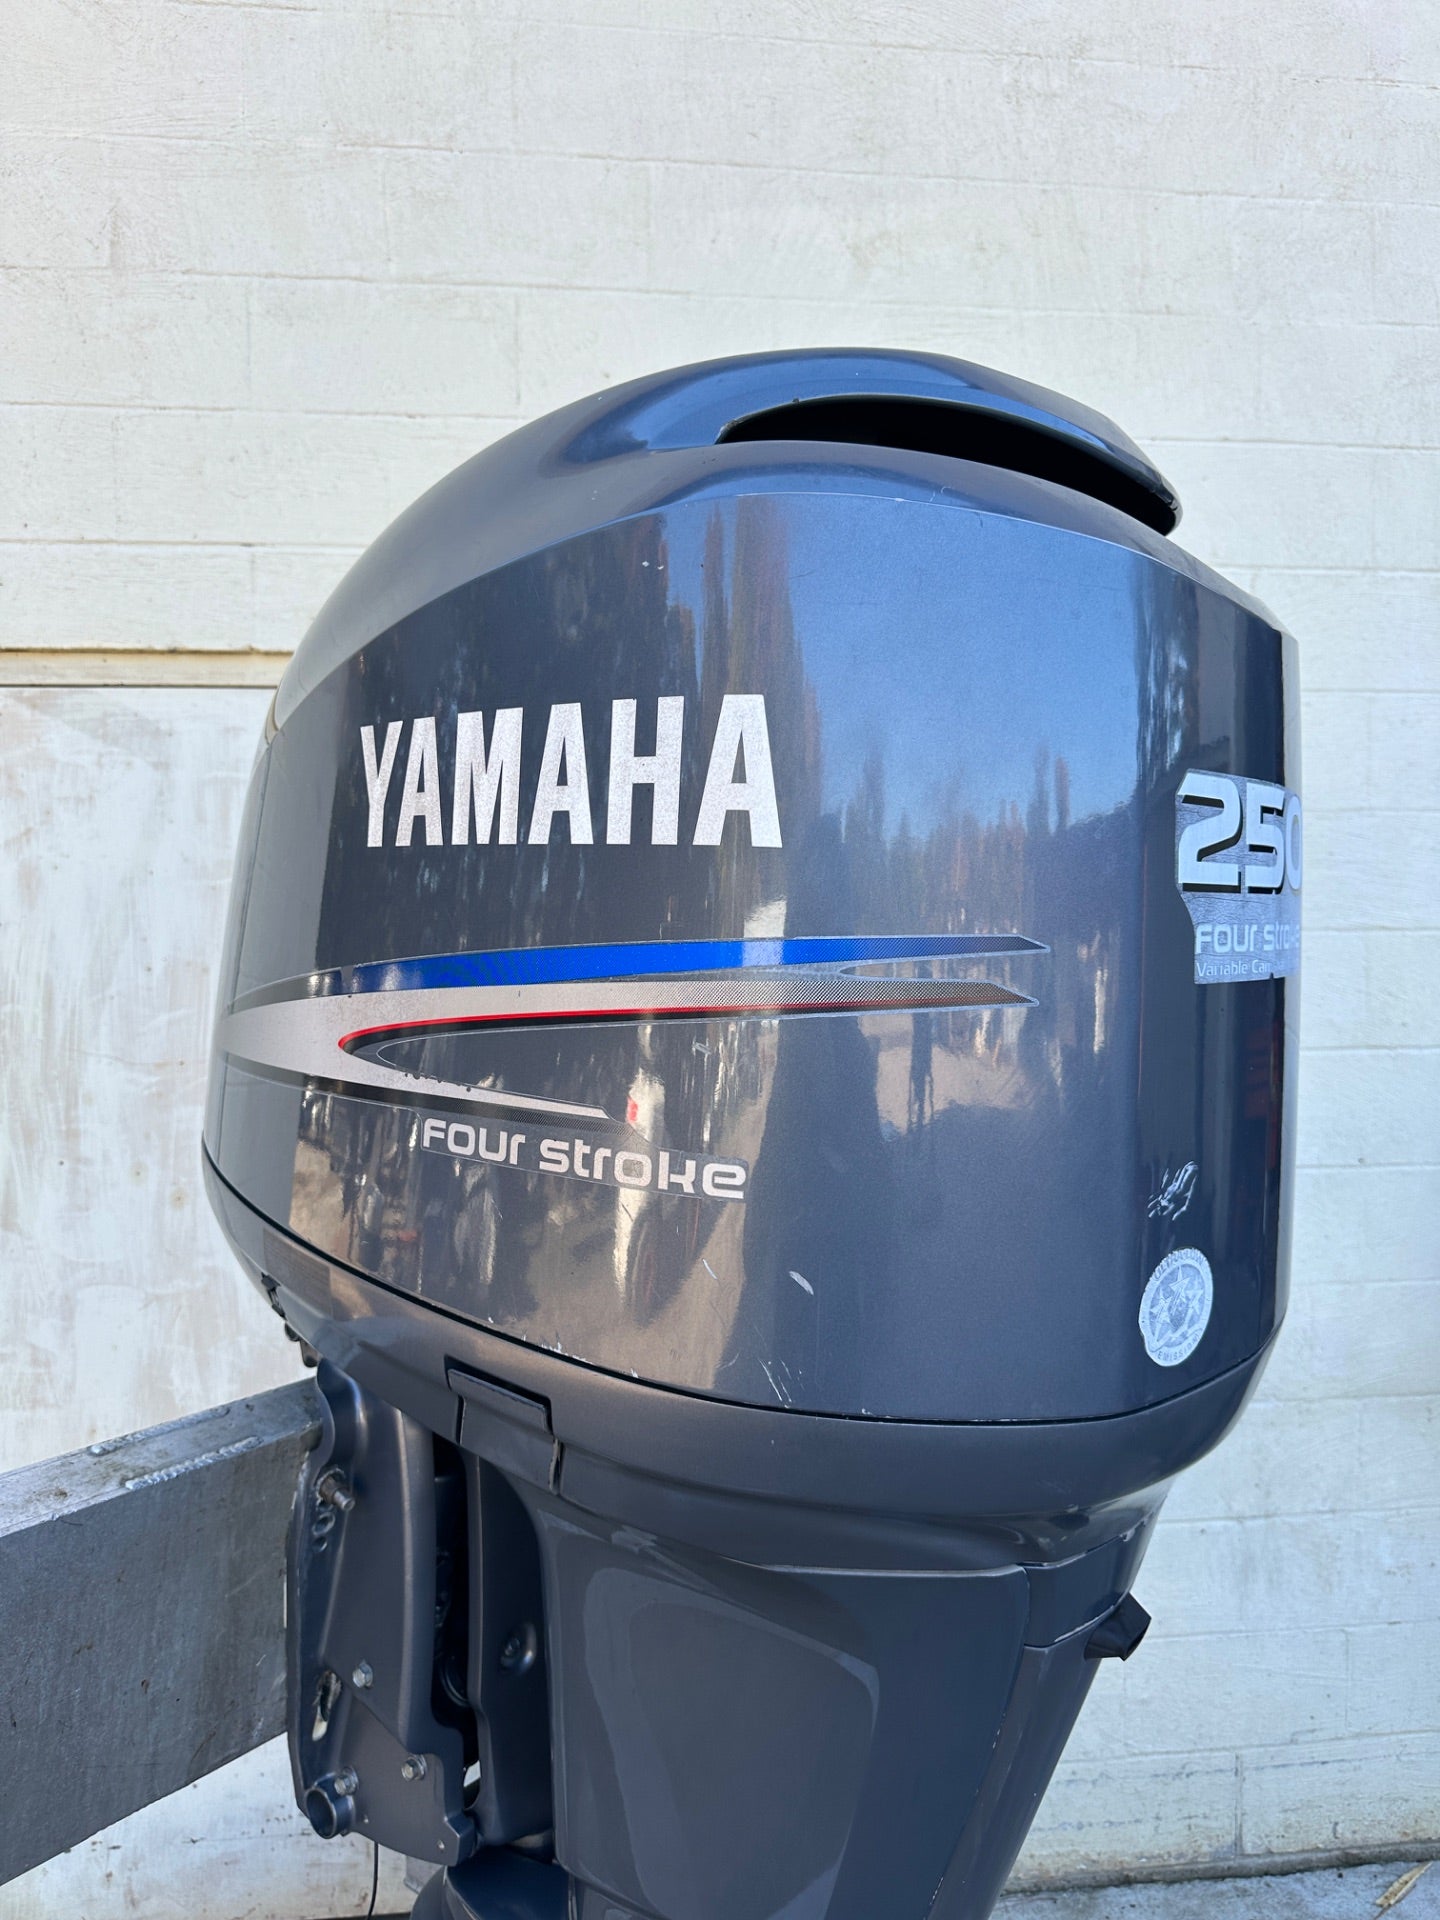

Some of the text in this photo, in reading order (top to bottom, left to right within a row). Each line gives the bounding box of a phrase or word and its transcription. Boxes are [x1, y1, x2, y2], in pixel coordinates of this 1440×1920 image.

[360, 694, 783, 849] YAMAHA
[1177, 772, 1302, 895] 250
[1196, 961, 1249, 977] Variable
[539, 1138, 747, 1200] stroke
